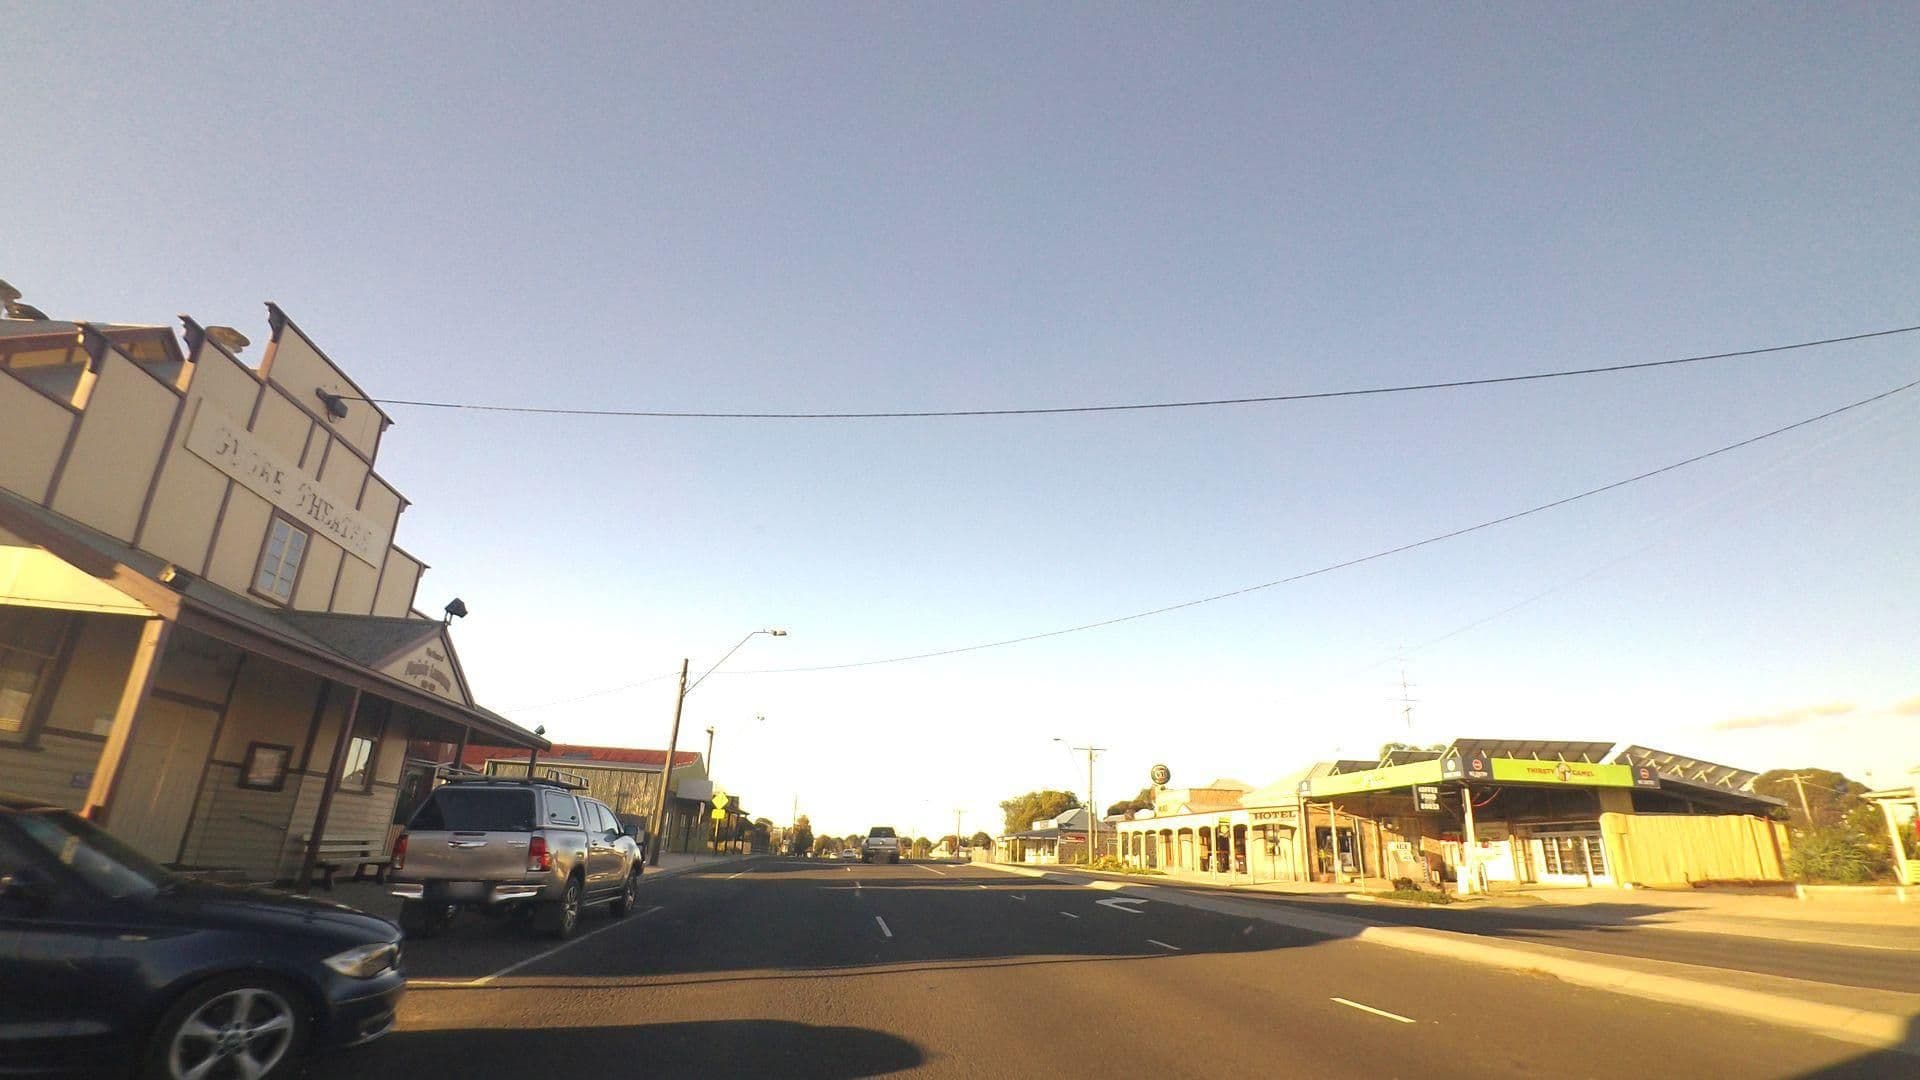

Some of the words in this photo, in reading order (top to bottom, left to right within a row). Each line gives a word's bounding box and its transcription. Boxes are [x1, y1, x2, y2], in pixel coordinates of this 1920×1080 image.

[1526, 767, 1554, 775] THIRSTY
[1572, 769, 1594, 777] CAMEL
[1254, 810, 1296, 821] HOTEL
